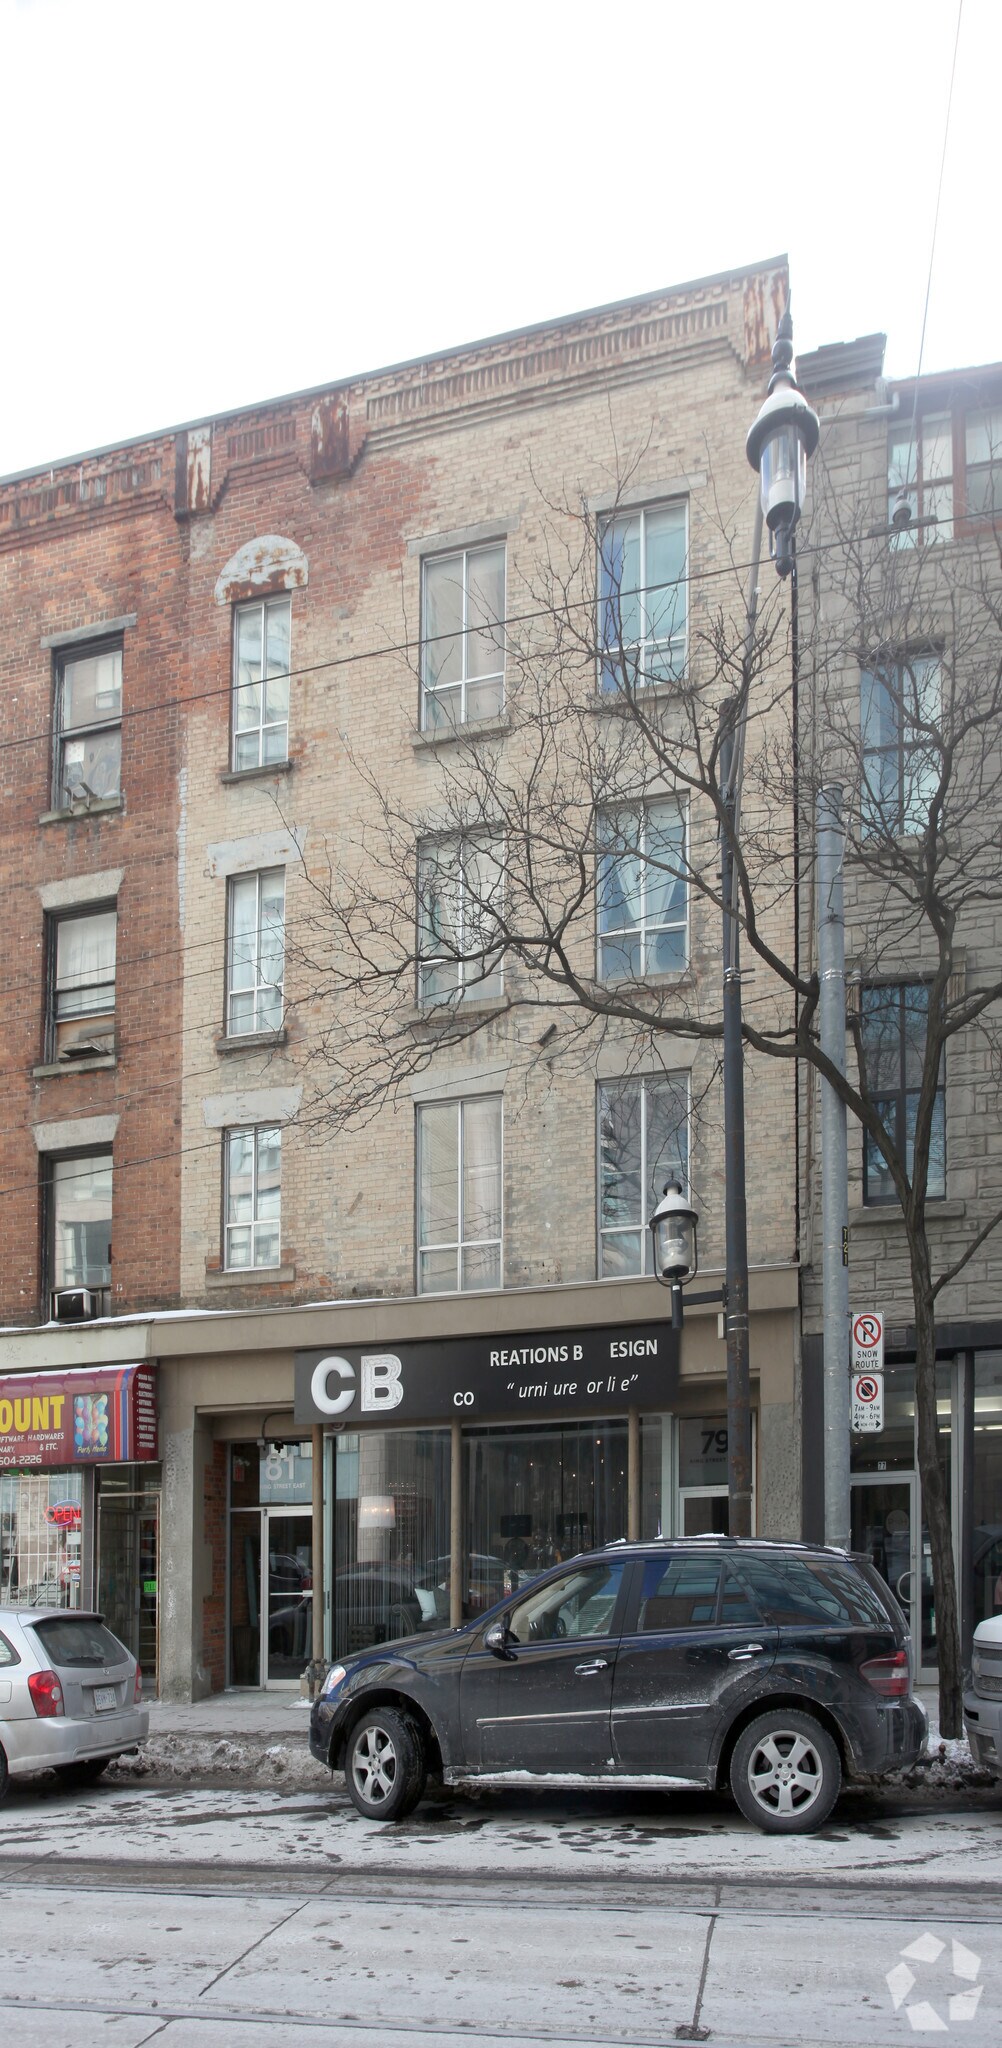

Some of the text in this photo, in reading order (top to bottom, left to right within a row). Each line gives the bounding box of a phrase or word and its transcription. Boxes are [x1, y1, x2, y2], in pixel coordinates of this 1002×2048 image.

[490, 1339, 658, 1367] REATIONS B ESIGN
[857, 1350, 878, 1359] SNOW
[855, 1360, 879, 1369] ROUTE
[311, 1354, 404, 1415] CB
[553, 1381, 578, 1396] ure
[586, 1380, 603, 1394] or
[453, 1391, 475, 1406] CO
[0, 1395, 65, 1434] OUNT
[27, 1432, 64, 1442] HARDWARES
[700, 1429, 729, 1455] 79
[45, 1442, 59, 1451] ETC.
[265, 1453, 295, 1481] 81
[878, 1462, 886, 1470] 77
[43, 1505, 81, 1522] OPEN
